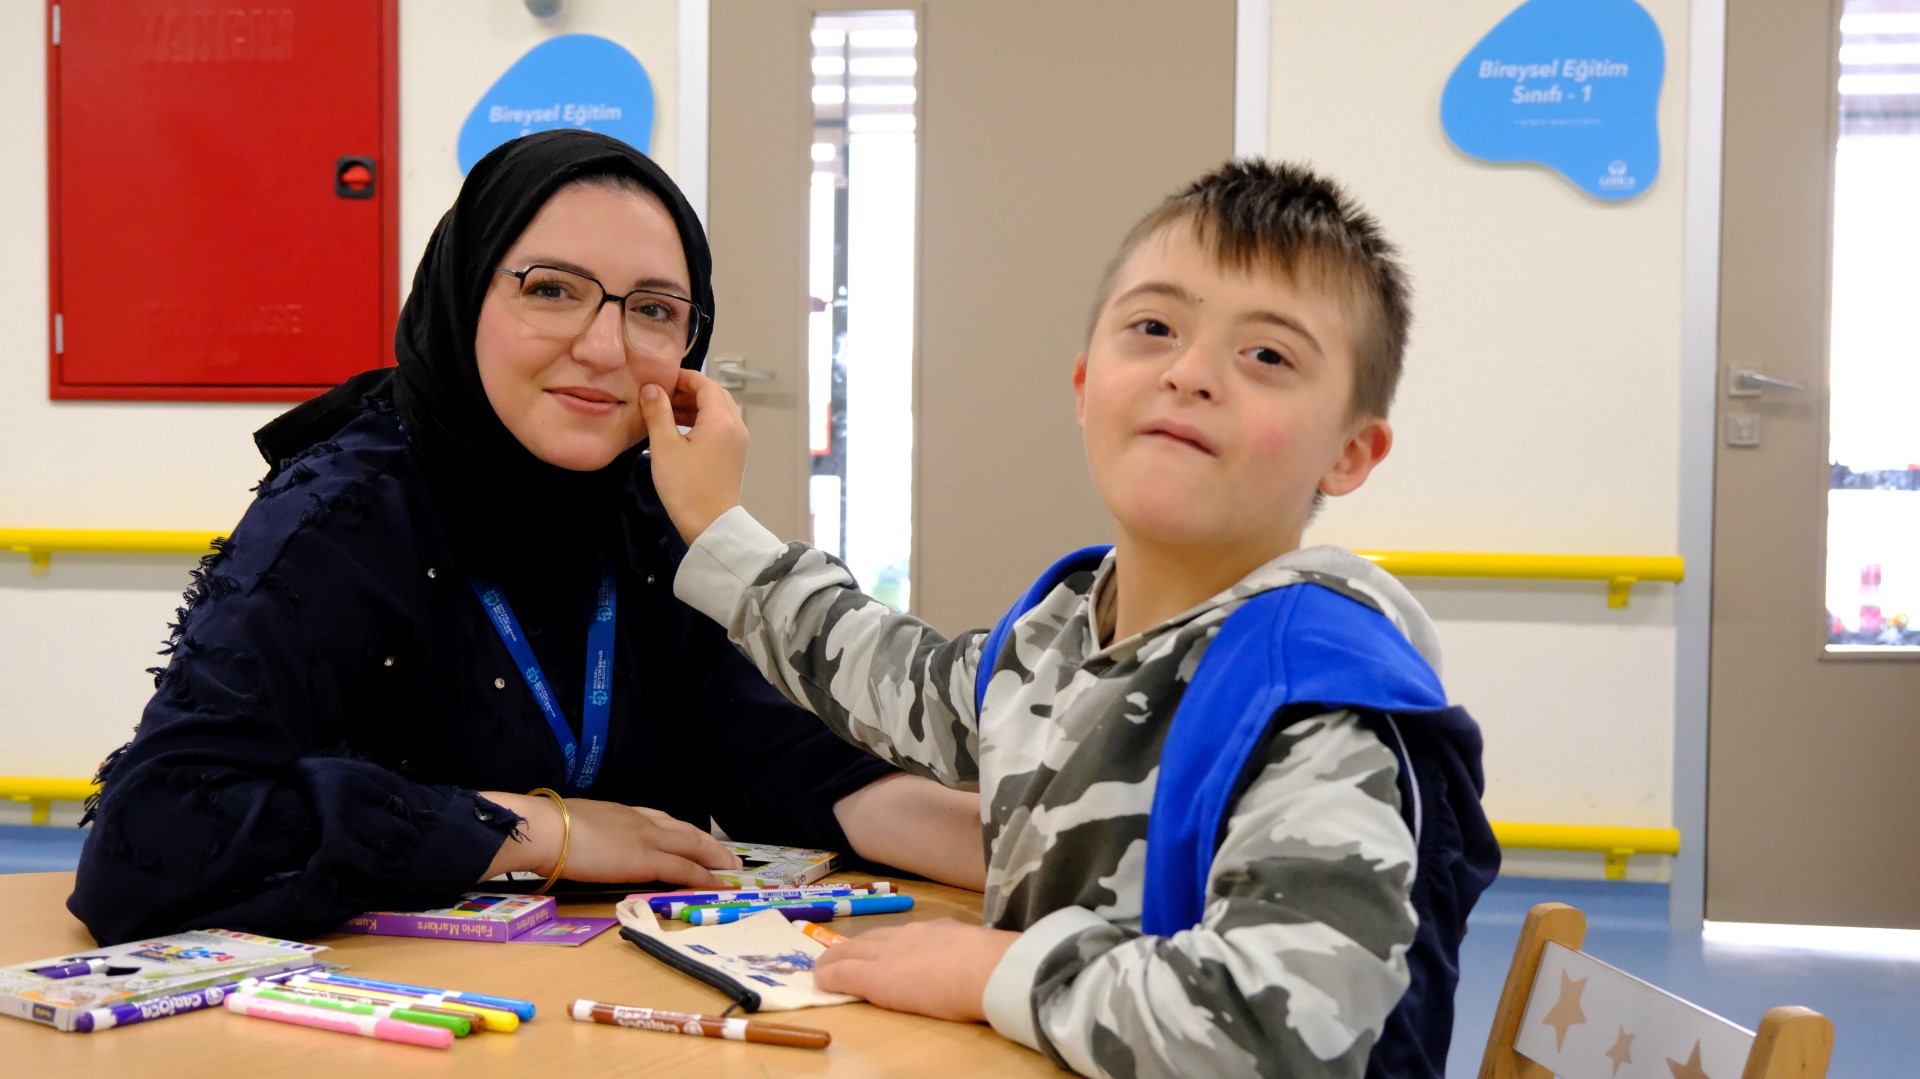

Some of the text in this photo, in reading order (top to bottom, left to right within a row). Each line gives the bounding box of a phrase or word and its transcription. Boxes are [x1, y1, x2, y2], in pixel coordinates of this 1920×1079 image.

[1478, 58, 1629, 82] Bireysel Eğitim
[1581, 85, 1593, 104] 1
[489, 103, 622, 125] Bireysel Eğitim
[344, 917, 377, 930] Kuma
[417, 921, 493, 937] Fabric Markers
[141, 995, 203, 1019] CARIOCA
